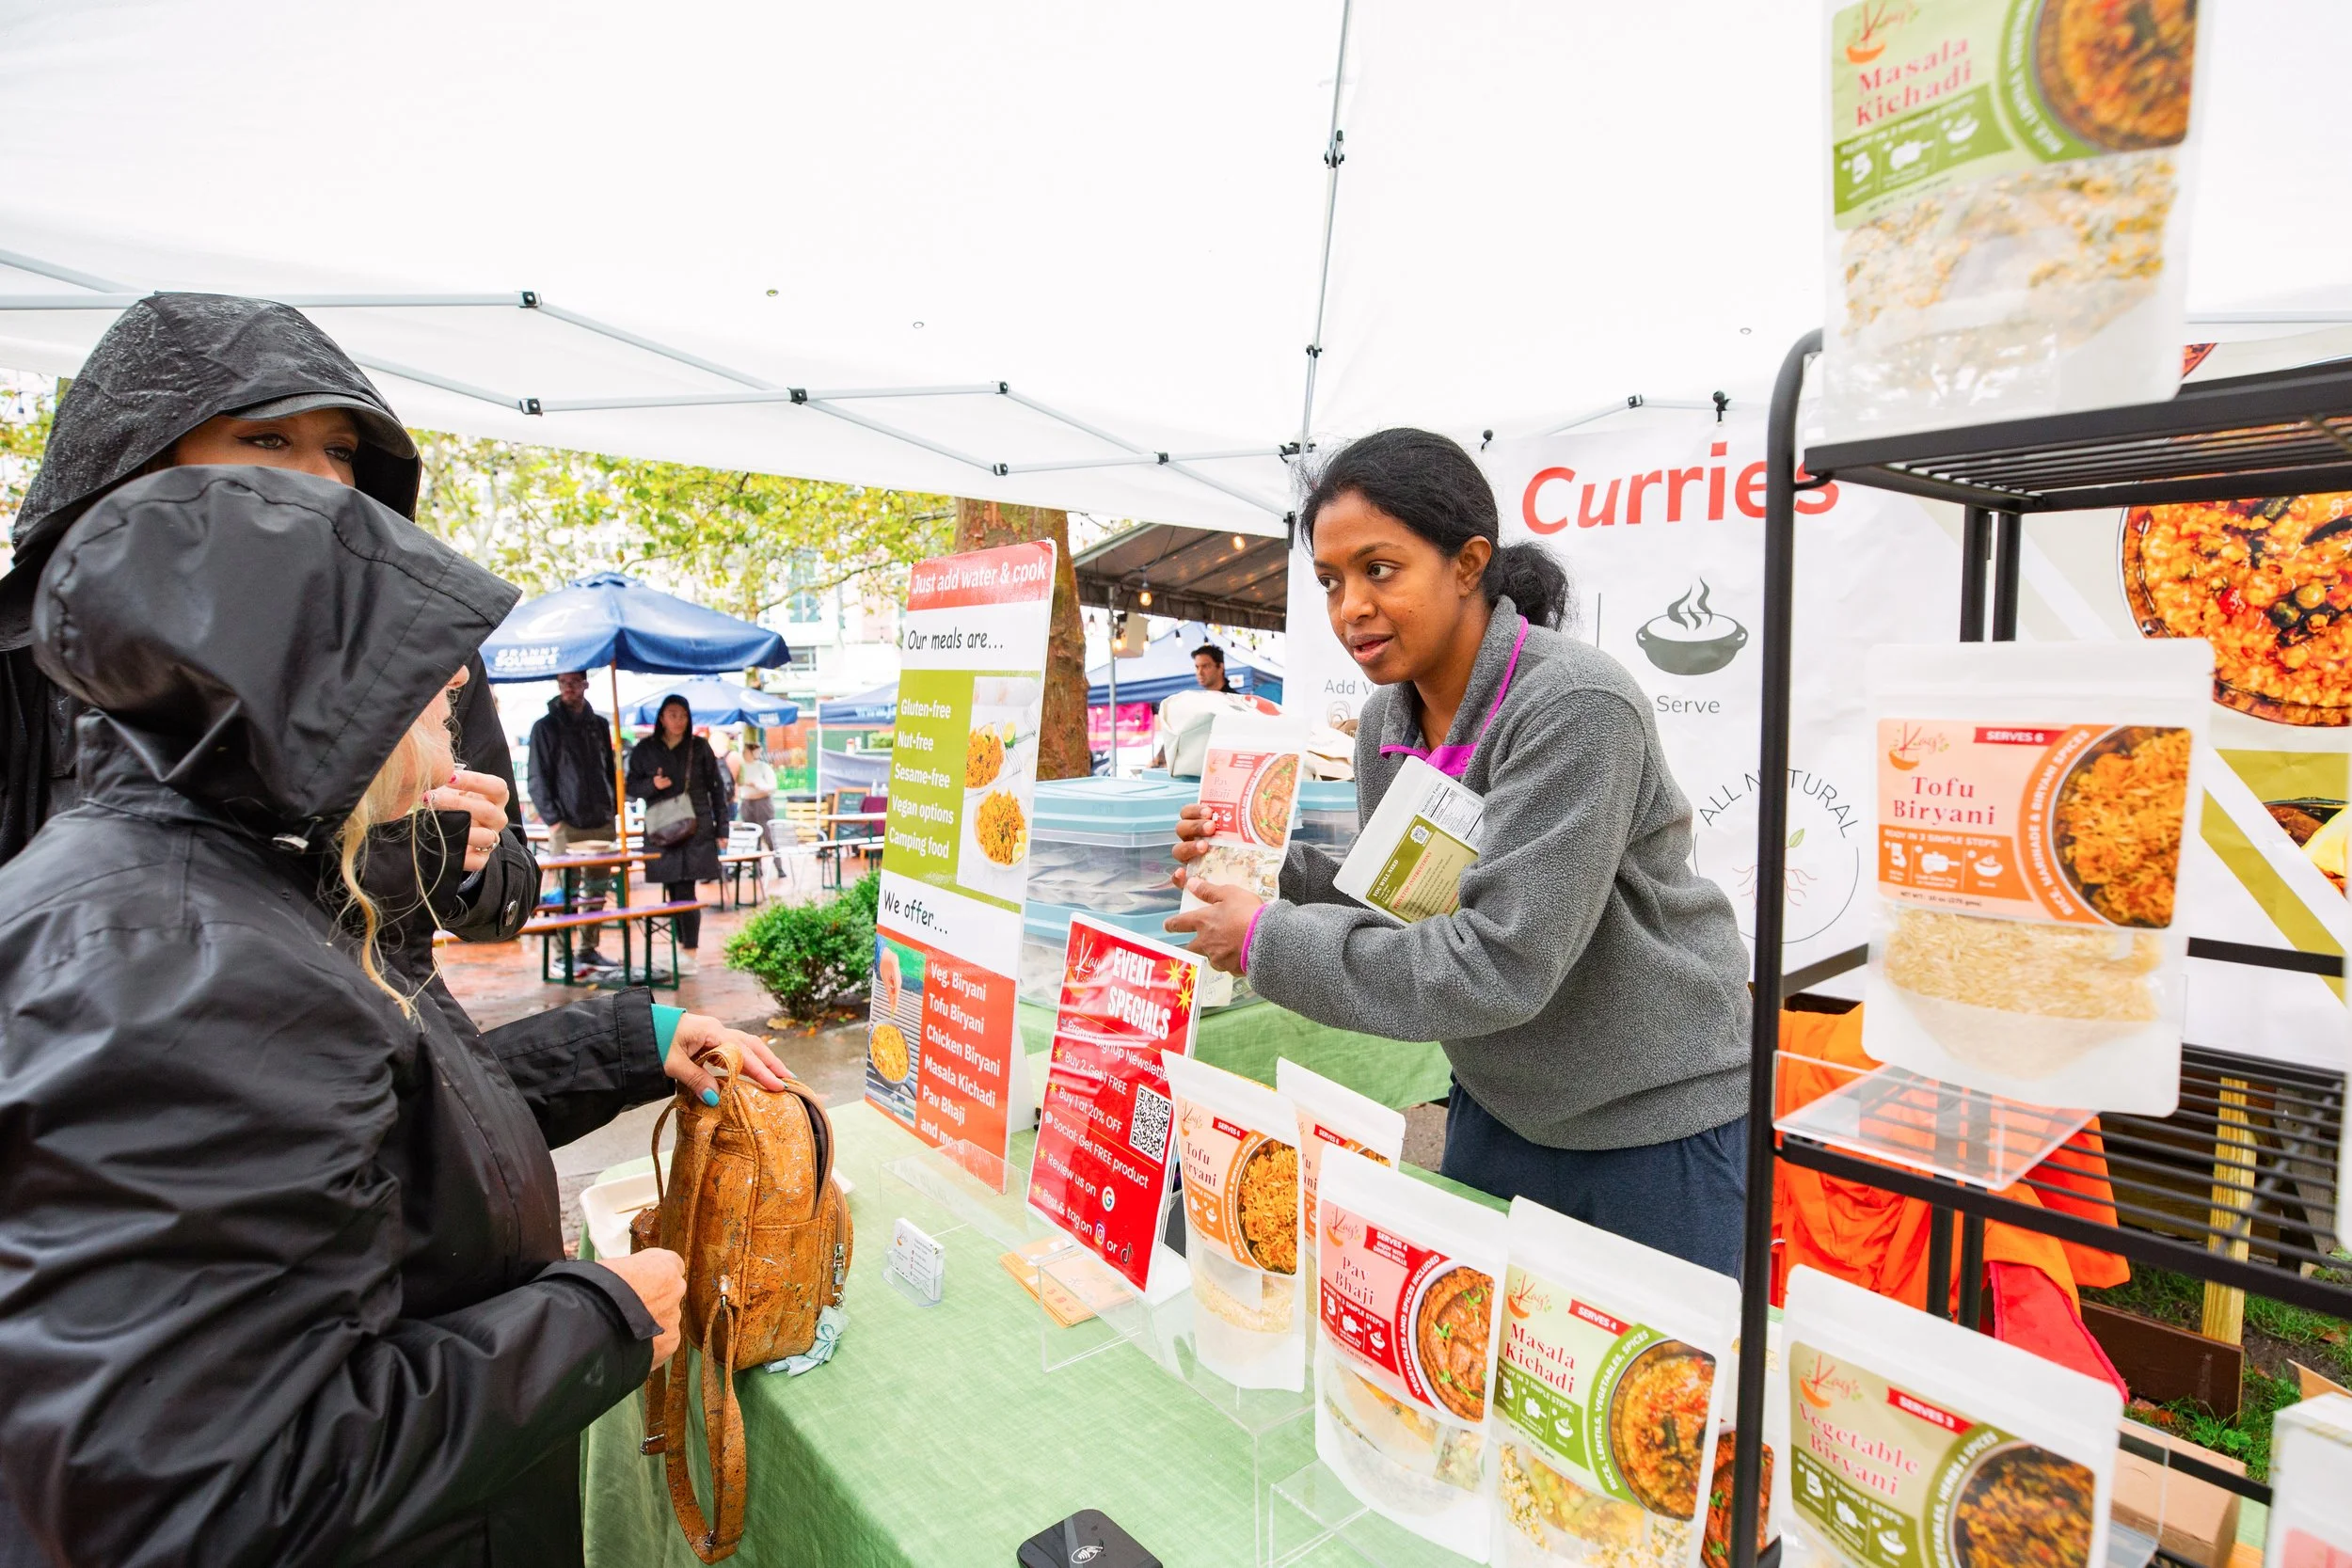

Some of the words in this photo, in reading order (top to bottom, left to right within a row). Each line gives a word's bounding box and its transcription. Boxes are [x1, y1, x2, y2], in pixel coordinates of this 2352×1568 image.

[1859, 39, 1968, 95] Masala
[1856, 58, 1971, 127] Kichadi
[1521, 442, 1841, 535] Curries
[913, 572, 937, 595] Just
[937, 569, 960, 591] add
[961, 565, 997, 590] water
[999, 561, 1010, 583] &
[1011, 556, 1047, 582] cook
[908, 629, 927, 651] Our
[930, 626, 962, 651] meals
[1324, 679, 1356, 695] Add
[900, 698, 951, 720] Gluten-free
[1656, 695, 1721, 715] Serve
[898, 732, 934, 752] Nut-free
[1986, 731, 2032, 742] SERVES
[895, 763, 950, 788] Sesame-free
[1912, 776, 1974, 799] Tofu
[892, 795, 917, 817] Vegan
[919, 802, 954, 825] options
[1699, 784, 1741, 827] ALL
[1744, 768, 1859, 838] NTURAL
[1894, 800, 1995, 827] Biryani
[888, 826, 925, 858] Camping
[928, 835, 949, 859] food
[883, 890, 900, 915] We
[930, 961, 950, 987] Veg.
[952, 974, 987, 1001] Biryani
[1112, 946, 1156, 990] EVENT
[930, 994, 949, 1017] Tofu
[950, 1006, 984, 1035] Biryani
[1107, 986, 1171, 1040] SPECIALS
[926, 1025, 962, 1056] Chicken
[964, 1045, 1000, 1077] Biryani
[1126, 1050, 1168, 1082] Newslette
[925, 1054, 957, 1088] Masala
[958, 1074, 995, 1108] Kichadi
[1065, 1052, 1079, 1069] Buy
[1089, 1065, 1103, 1081] Get
[1107, 1075, 1128, 1096] FREE
[922, 1085, 940, 1108] Pav
[941, 1095, 965, 1127] Bhaji
[1058, 1087, 1074, 1107] Buy
[1078, 1099, 1088, 1114] at
[1089, 1104, 1105, 1124] 20%
[1106, 1116, 1122, 1134] OFF
[921, 1118, 938, 1139] and
[1217, 1122, 1237, 1135] SERVES
[1319, 1129, 1336, 1143] SERVES
[1053, 1117, 1078, 1142] Social:
[1078, 1135, 1093, 1153] Get
[1094, 1141, 1113, 1164] FREE
[1113, 1158, 1150, 1190] product
[1185, 1141, 1211, 1165] Tofu
[1047, 1153, 1074, 1180] Review
[1074, 1171, 1085, 1187] us
[1085, 1179, 1096, 1196] on
[1042, 1189, 1058, 1212] Post
[1057, 1201, 1065, 1216] &
[1067, 1207, 1081, 1229] tag
[1081, 1219, 1092, 1236] on
[1106, 1240, 1118, 1254] or
[1376, 1230, 1403, 1249] SERVES
[1343, 1256, 1370, 1280] Pav
[1412, 1254, 1440, 1286] INCLUDED
[1335, 1271, 1374, 1306] Bhaji
[1402, 1284, 1416, 1313] SPICES
[1578, 1306, 1611, 1327] SERVES
[1611, 1322, 1617, 1330] 4
[1510, 1323, 1576, 1370] Masala
[1621, 1330, 1649, 1355] SPICES
[1400, 1337, 1422, 1396] VEGETABLES
[1505, 1341, 1575, 1394] Kichadi
[1798, 1401, 1920, 1476] Vegetable
[1809, 1432, 1899, 1497] Biryani
